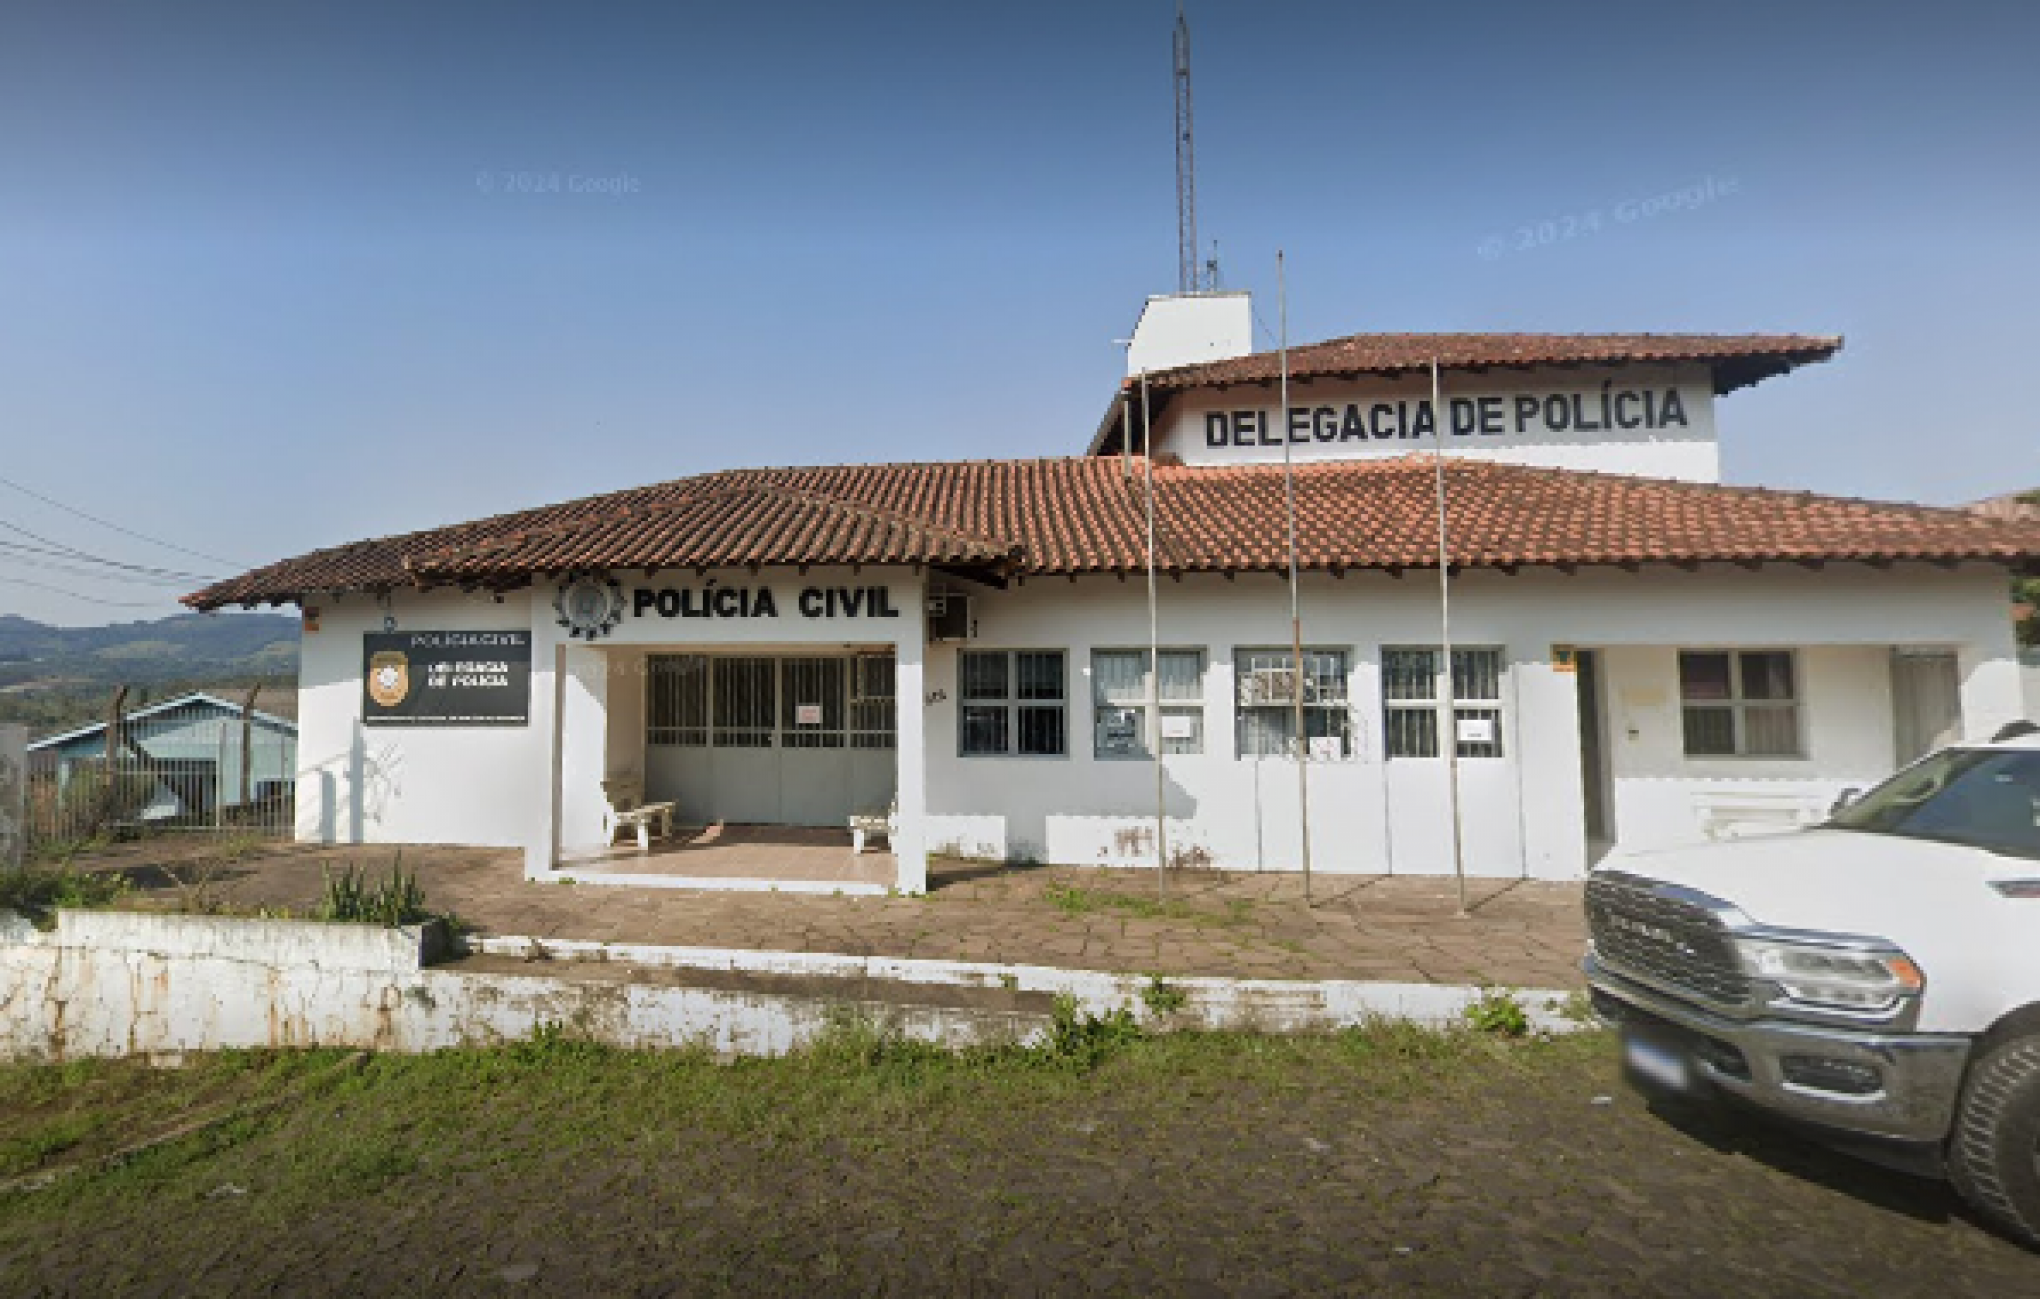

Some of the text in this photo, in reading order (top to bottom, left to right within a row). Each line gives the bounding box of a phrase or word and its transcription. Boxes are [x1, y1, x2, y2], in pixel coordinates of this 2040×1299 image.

[1206, 379, 1688, 447] DELEGACIA DE POLÍCIA
[634, 578, 899, 618] POLÍCIA CIVIL
